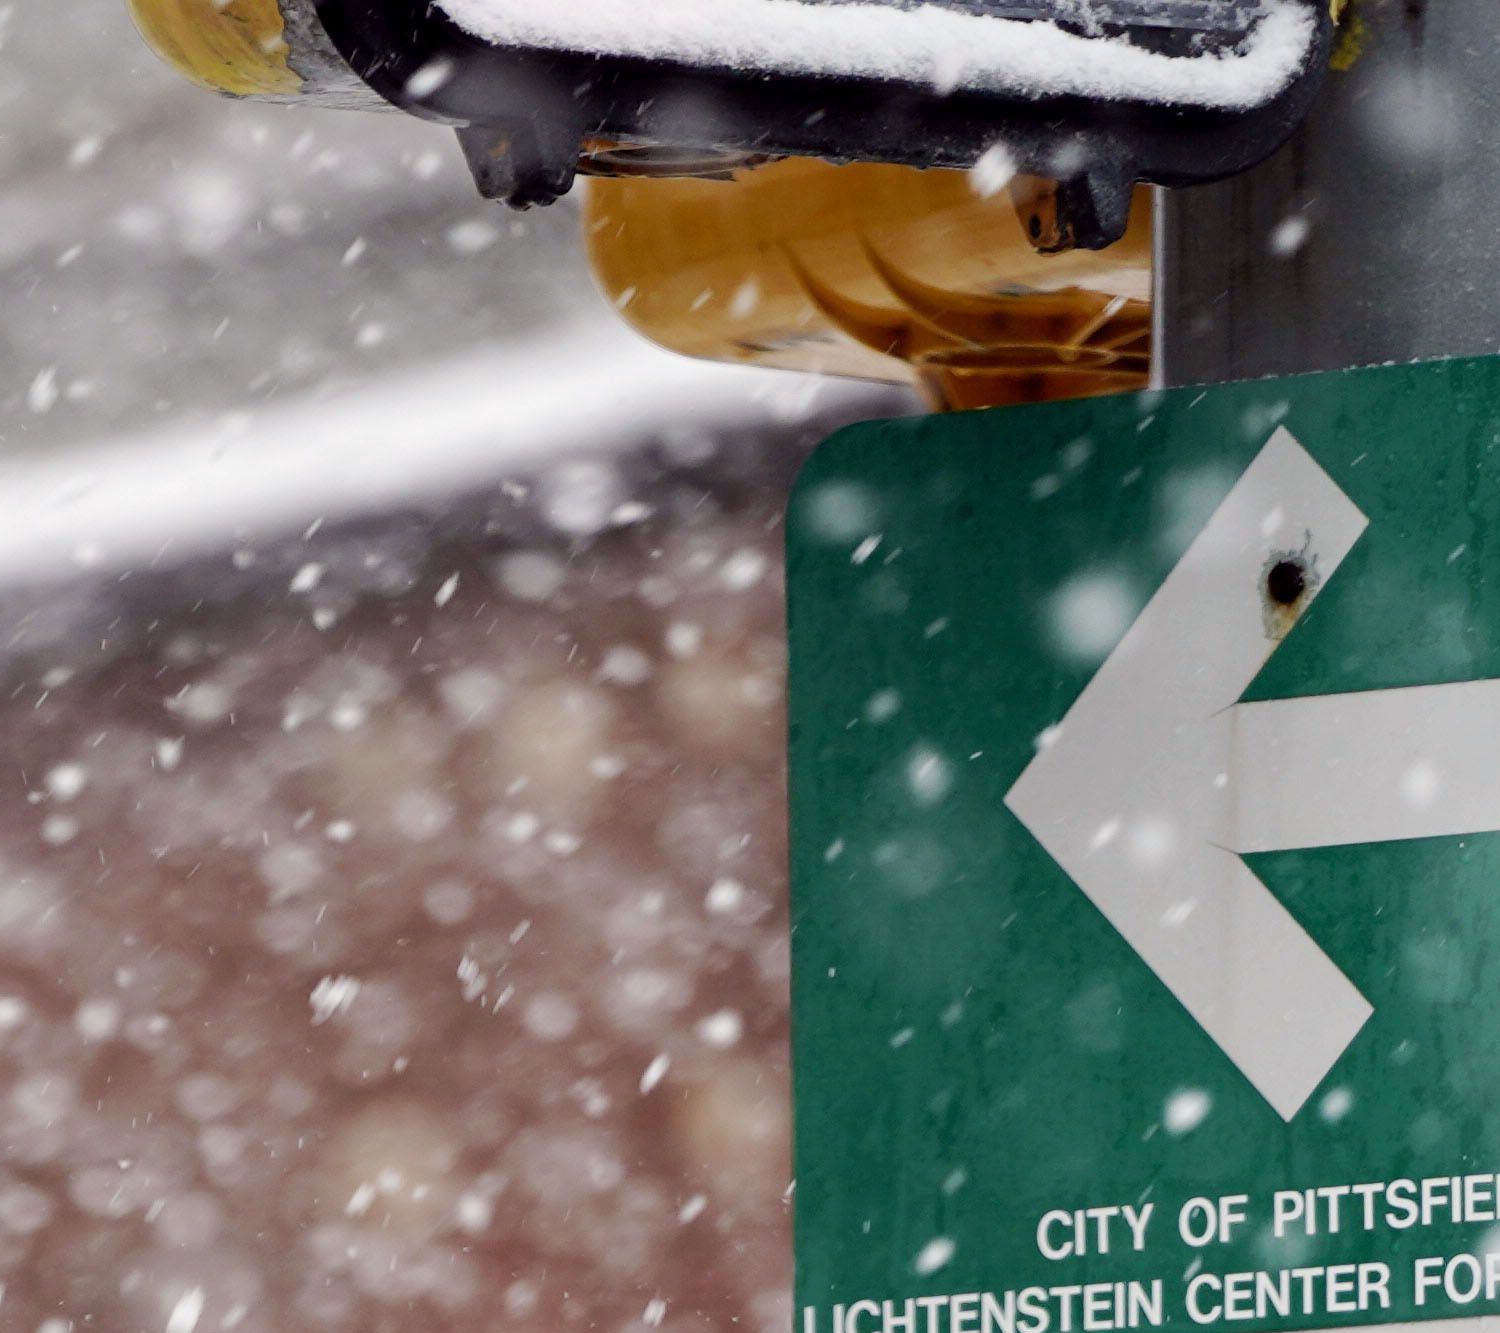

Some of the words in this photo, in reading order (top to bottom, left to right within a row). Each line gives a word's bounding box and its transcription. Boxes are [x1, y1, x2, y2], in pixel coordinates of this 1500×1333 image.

[1037, 1203, 1154, 1261] CITY
[1178, 1195, 1248, 1248] OF
[1185, 1262, 1390, 1324] CENTER
